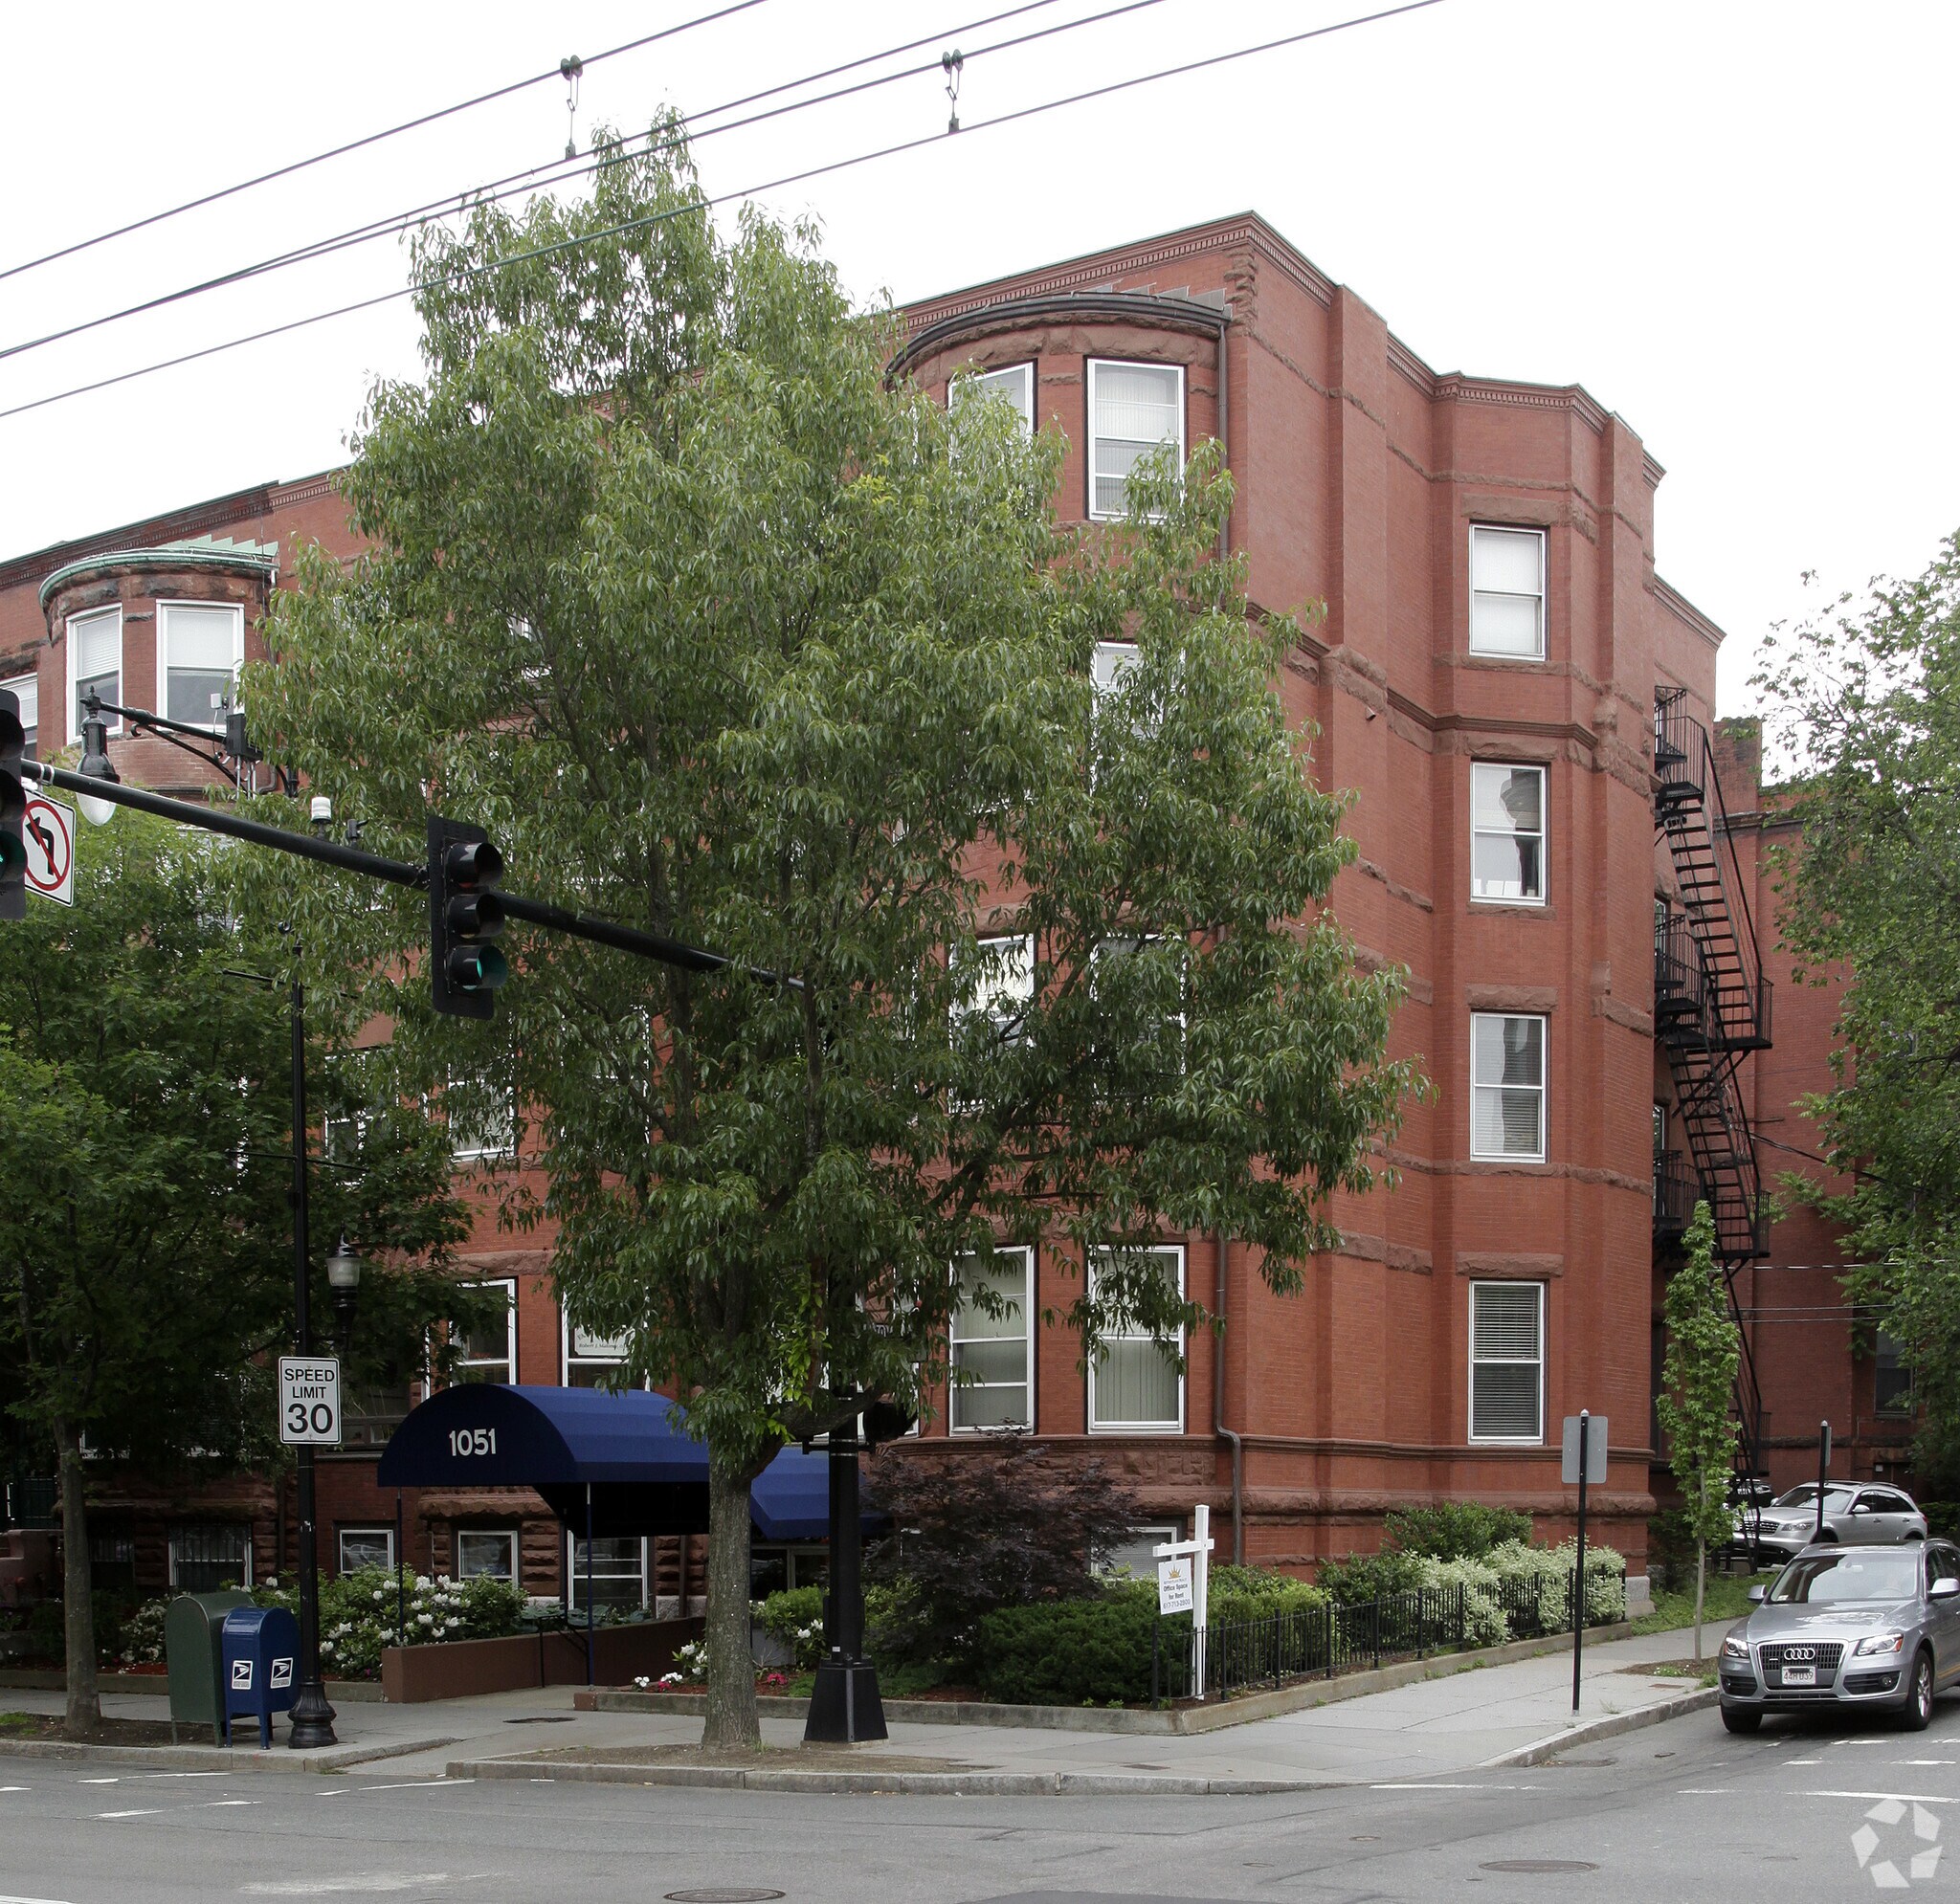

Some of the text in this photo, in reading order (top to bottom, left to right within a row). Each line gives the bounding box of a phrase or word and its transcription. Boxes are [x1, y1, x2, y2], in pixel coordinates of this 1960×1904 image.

[284, 1368, 335, 1382] SPEED
[292, 1386, 327, 1399] LIMIT
[287, 1403, 333, 1434] 30
[449, 1428, 497, 1456] 1051
